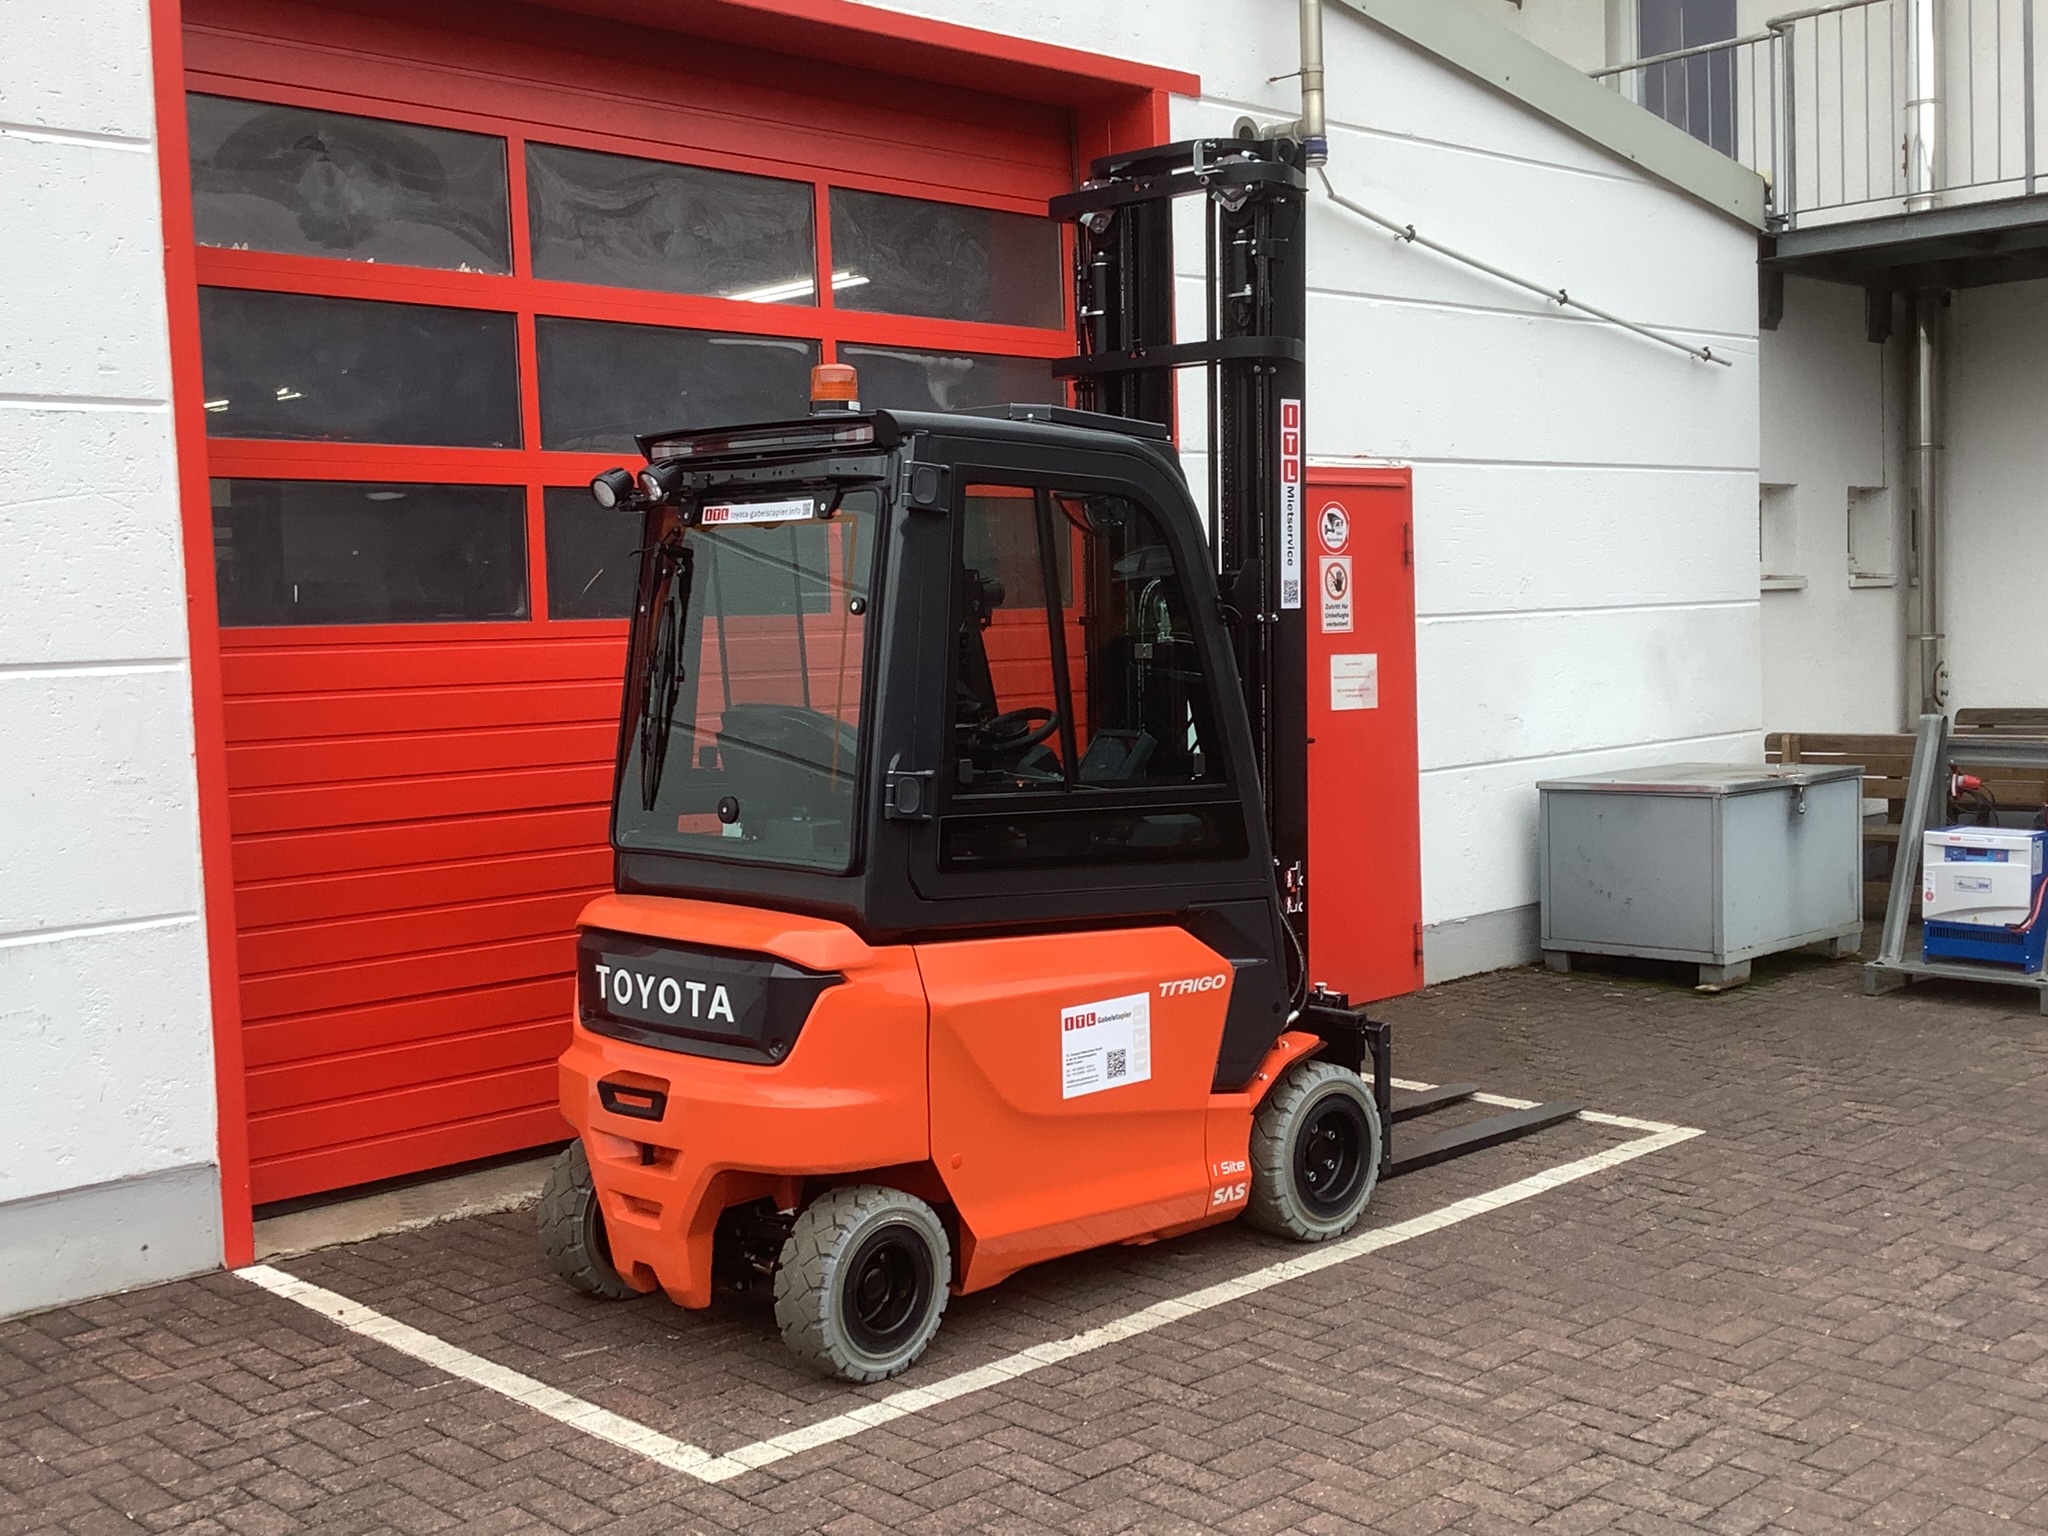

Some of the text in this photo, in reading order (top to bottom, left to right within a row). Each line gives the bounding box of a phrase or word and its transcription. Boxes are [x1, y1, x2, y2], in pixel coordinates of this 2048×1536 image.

[1285, 404, 1297, 482] ITL
[705, 508, 728, 521] ITL
[1286, 486, 1295, 567] Mietservice
[595, 964, 735, 1023] TOYOTA
[1066, 1011, 1132, 1030] ITL Gabelstapler
[1221, 1160, 1246, 1175] Site
[1212, 1182, 1247, 1206] SAS
